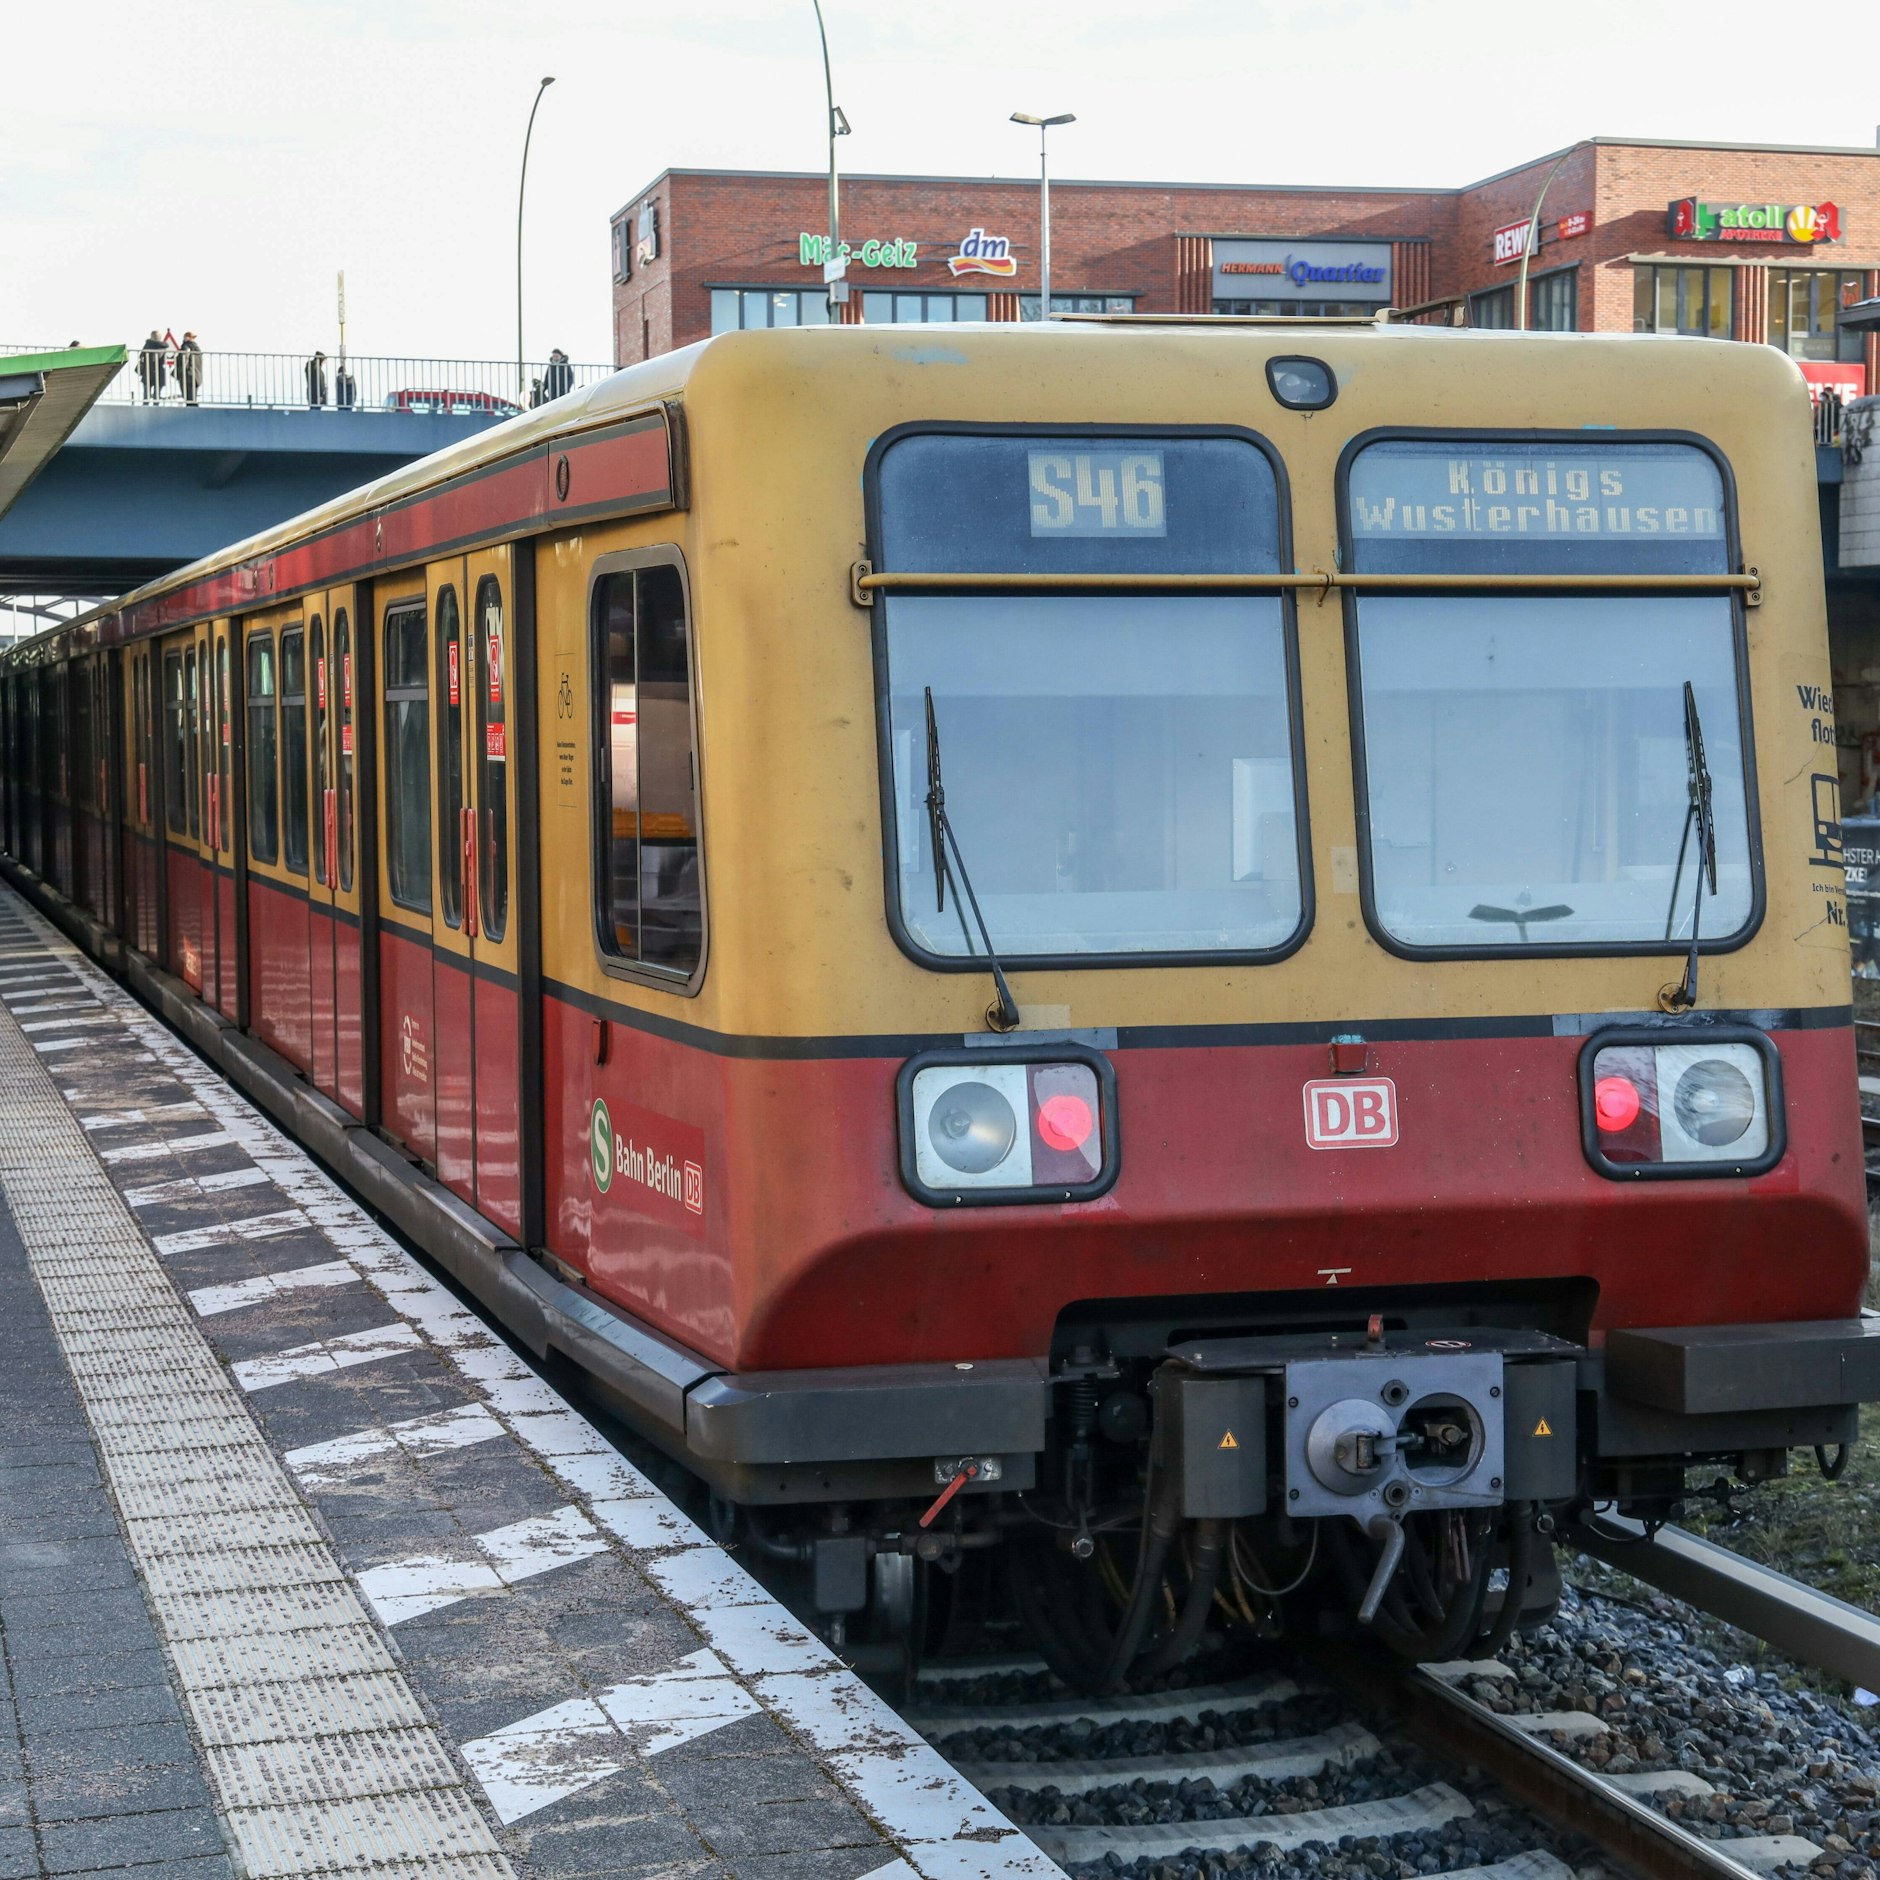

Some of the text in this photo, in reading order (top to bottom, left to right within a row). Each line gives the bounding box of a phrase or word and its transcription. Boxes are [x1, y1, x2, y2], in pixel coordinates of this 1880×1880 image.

[1719, 204, 1785, 229] atoll
[963, 230, 1007, 259] dm
[1221, 260, 1386, 287] HERMANN Quartier
[1031, 454, 1164, 529] S46
[1448, 460, 1624, 501] Königs
[1356, 497, 1718, 533] Wusterhausen
[1812, 883, 1824, 893] Ich
[1825, 884, 1835, 893] bin
[1313, 1087, 1390, 1140] DB
[594, 1108, 701, 1207] S Bahn Berlin DB
